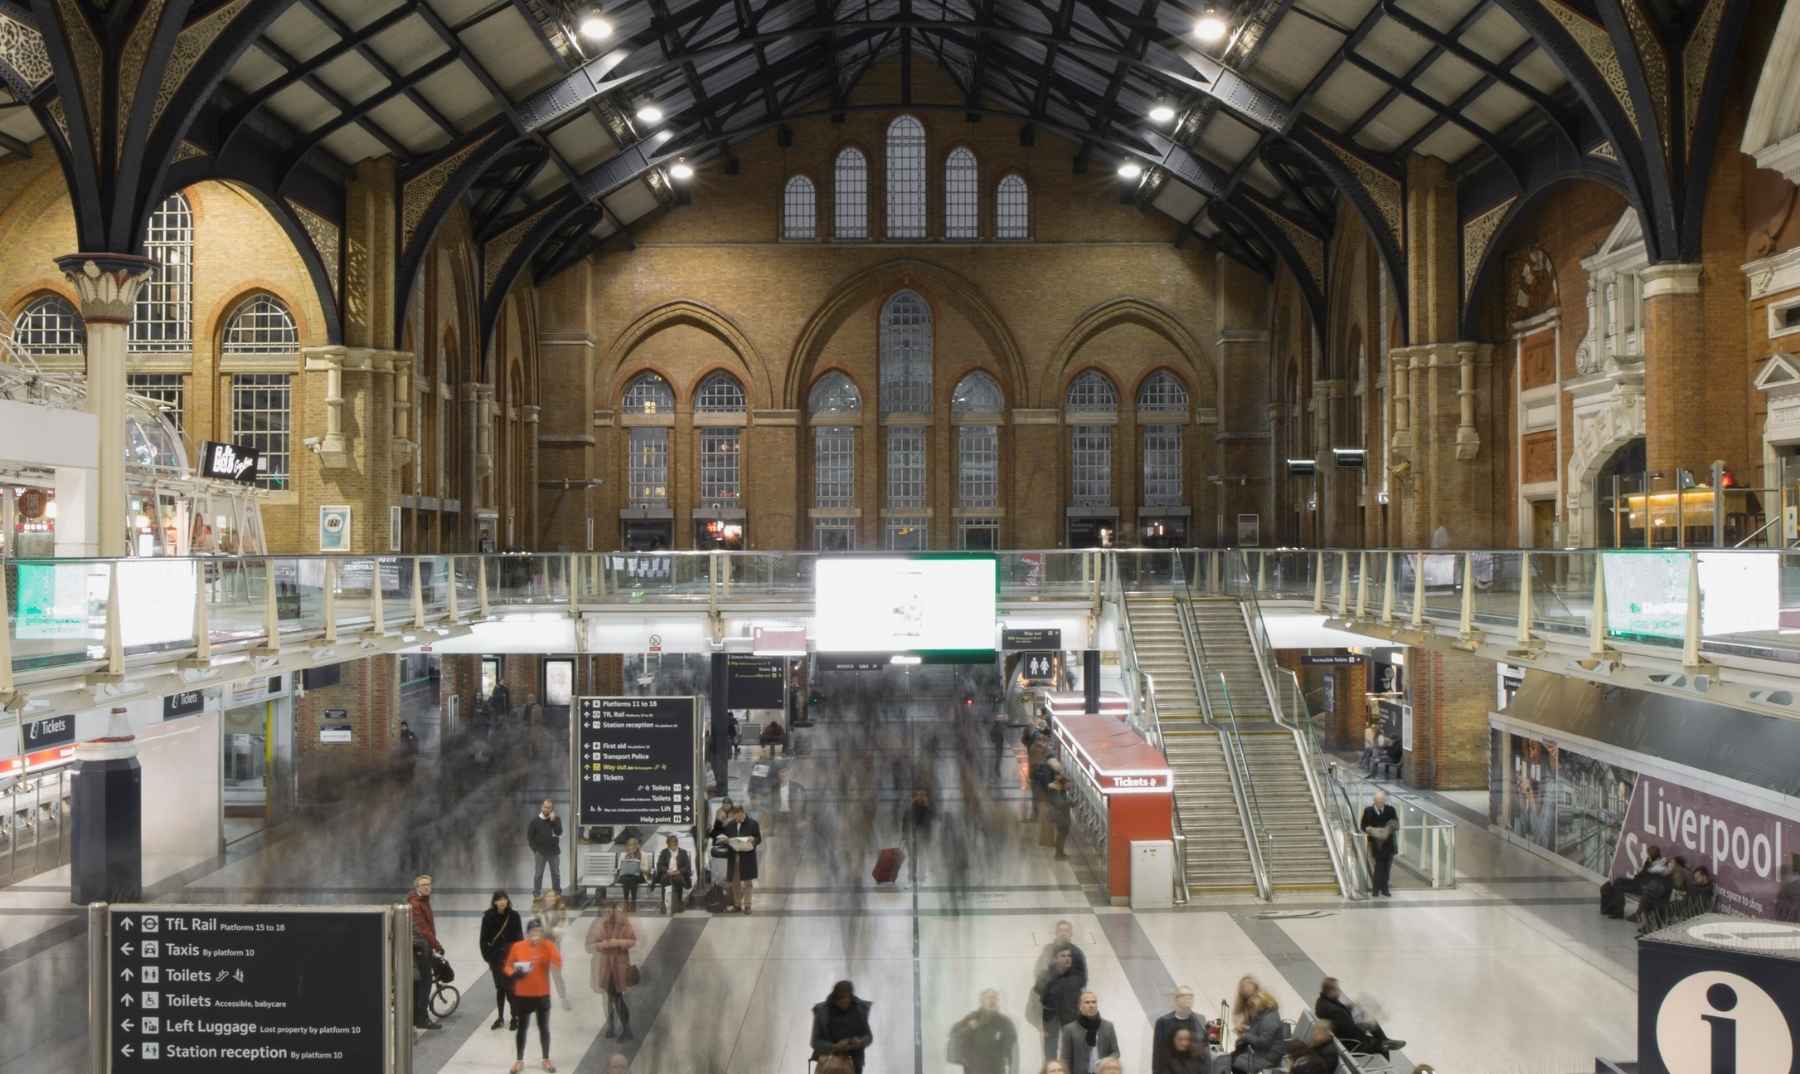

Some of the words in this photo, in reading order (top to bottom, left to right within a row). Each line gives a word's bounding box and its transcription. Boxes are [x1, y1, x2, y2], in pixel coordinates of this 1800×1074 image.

[41, 720, 66, 735] Tickets
[1113, 776, 1147, 786] Tickets
[1644, 780, 1782, 882] Liverpool
[165, 918, 188, 930] TfL
[192, 918, 216, 930] Rail
[166, 943, 199, 956] Taxis
[203, 949, 212, 957] By
[214, 949, 244, 957] platform
[166, 969, 211, 981] Toilets
[166, 994, 211, 1007] Toilets
[167, 1020, 194, 1032] Left
[198, 1020, 256, 1035] Luggage
[309, 1026, 319, 1034] by
[320, 1026, 350, 1034] platform
[167, 1045, 216, 1058] Station
[221, 1046, 287, 1060] reception
